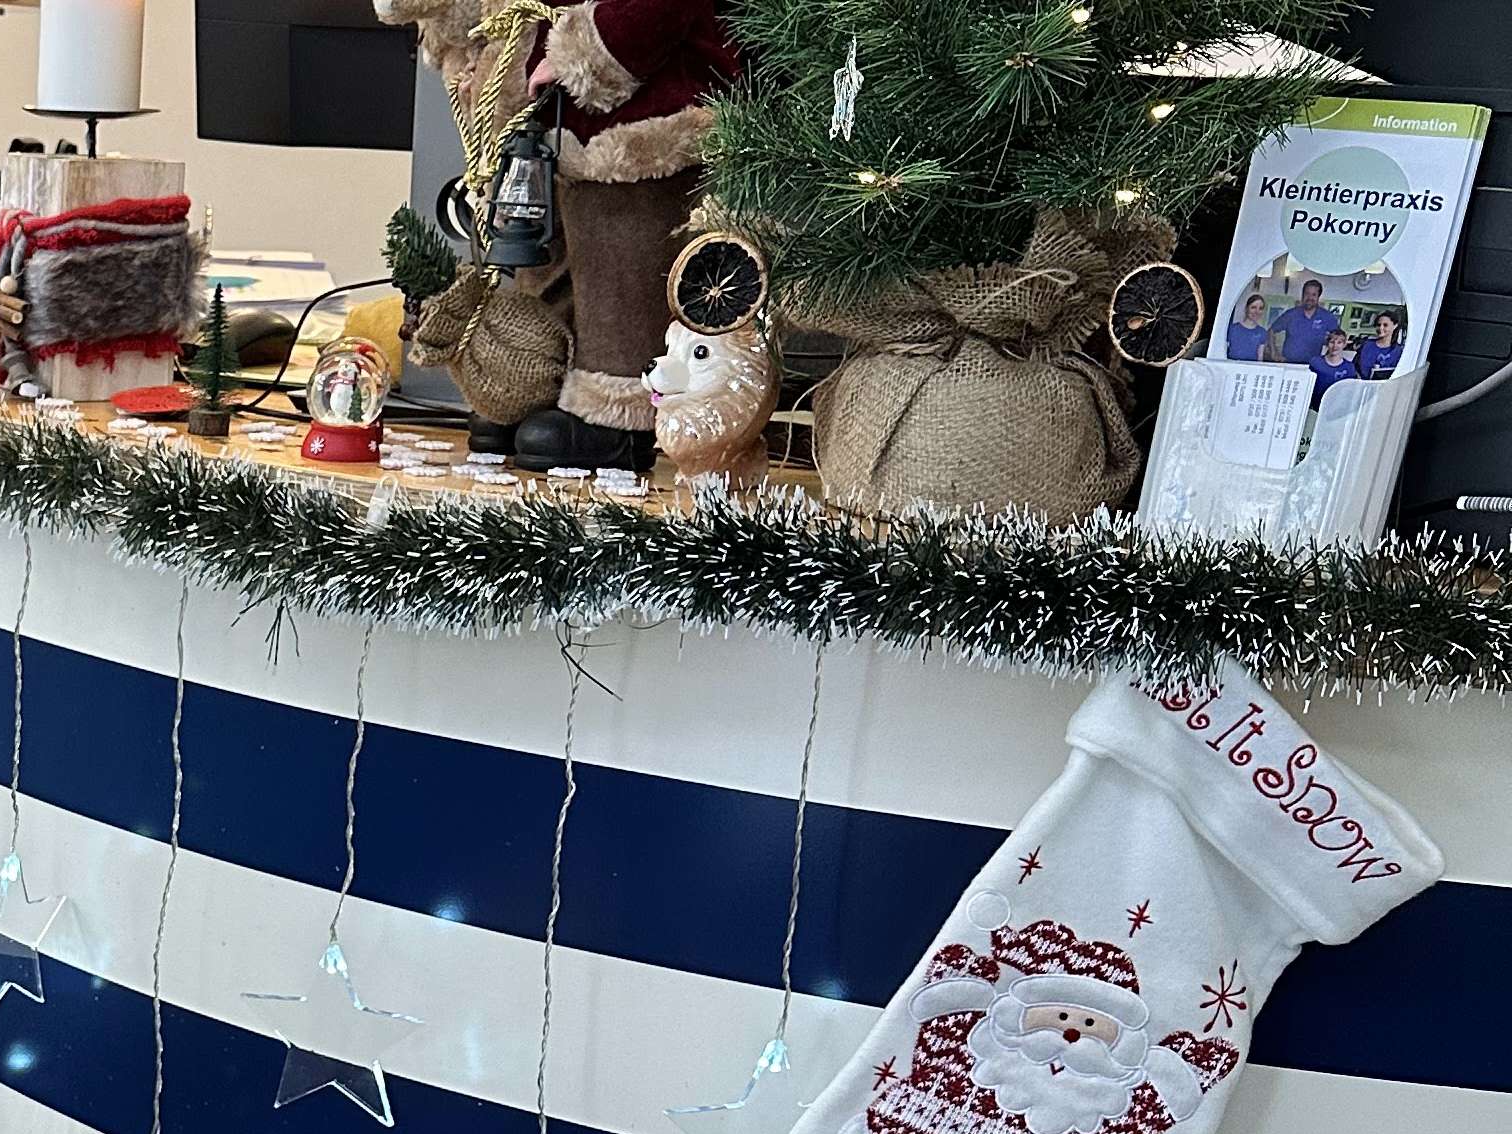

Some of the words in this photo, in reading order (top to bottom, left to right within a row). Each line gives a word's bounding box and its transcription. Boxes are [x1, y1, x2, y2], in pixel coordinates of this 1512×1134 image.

[1373, 114, 1458, 133] Information
[1259, 176, 1445, 212] Kleintierpraxis
[1290, 209, 1397, 244] Pokorny
[1204, 702, 1267, 767] It
